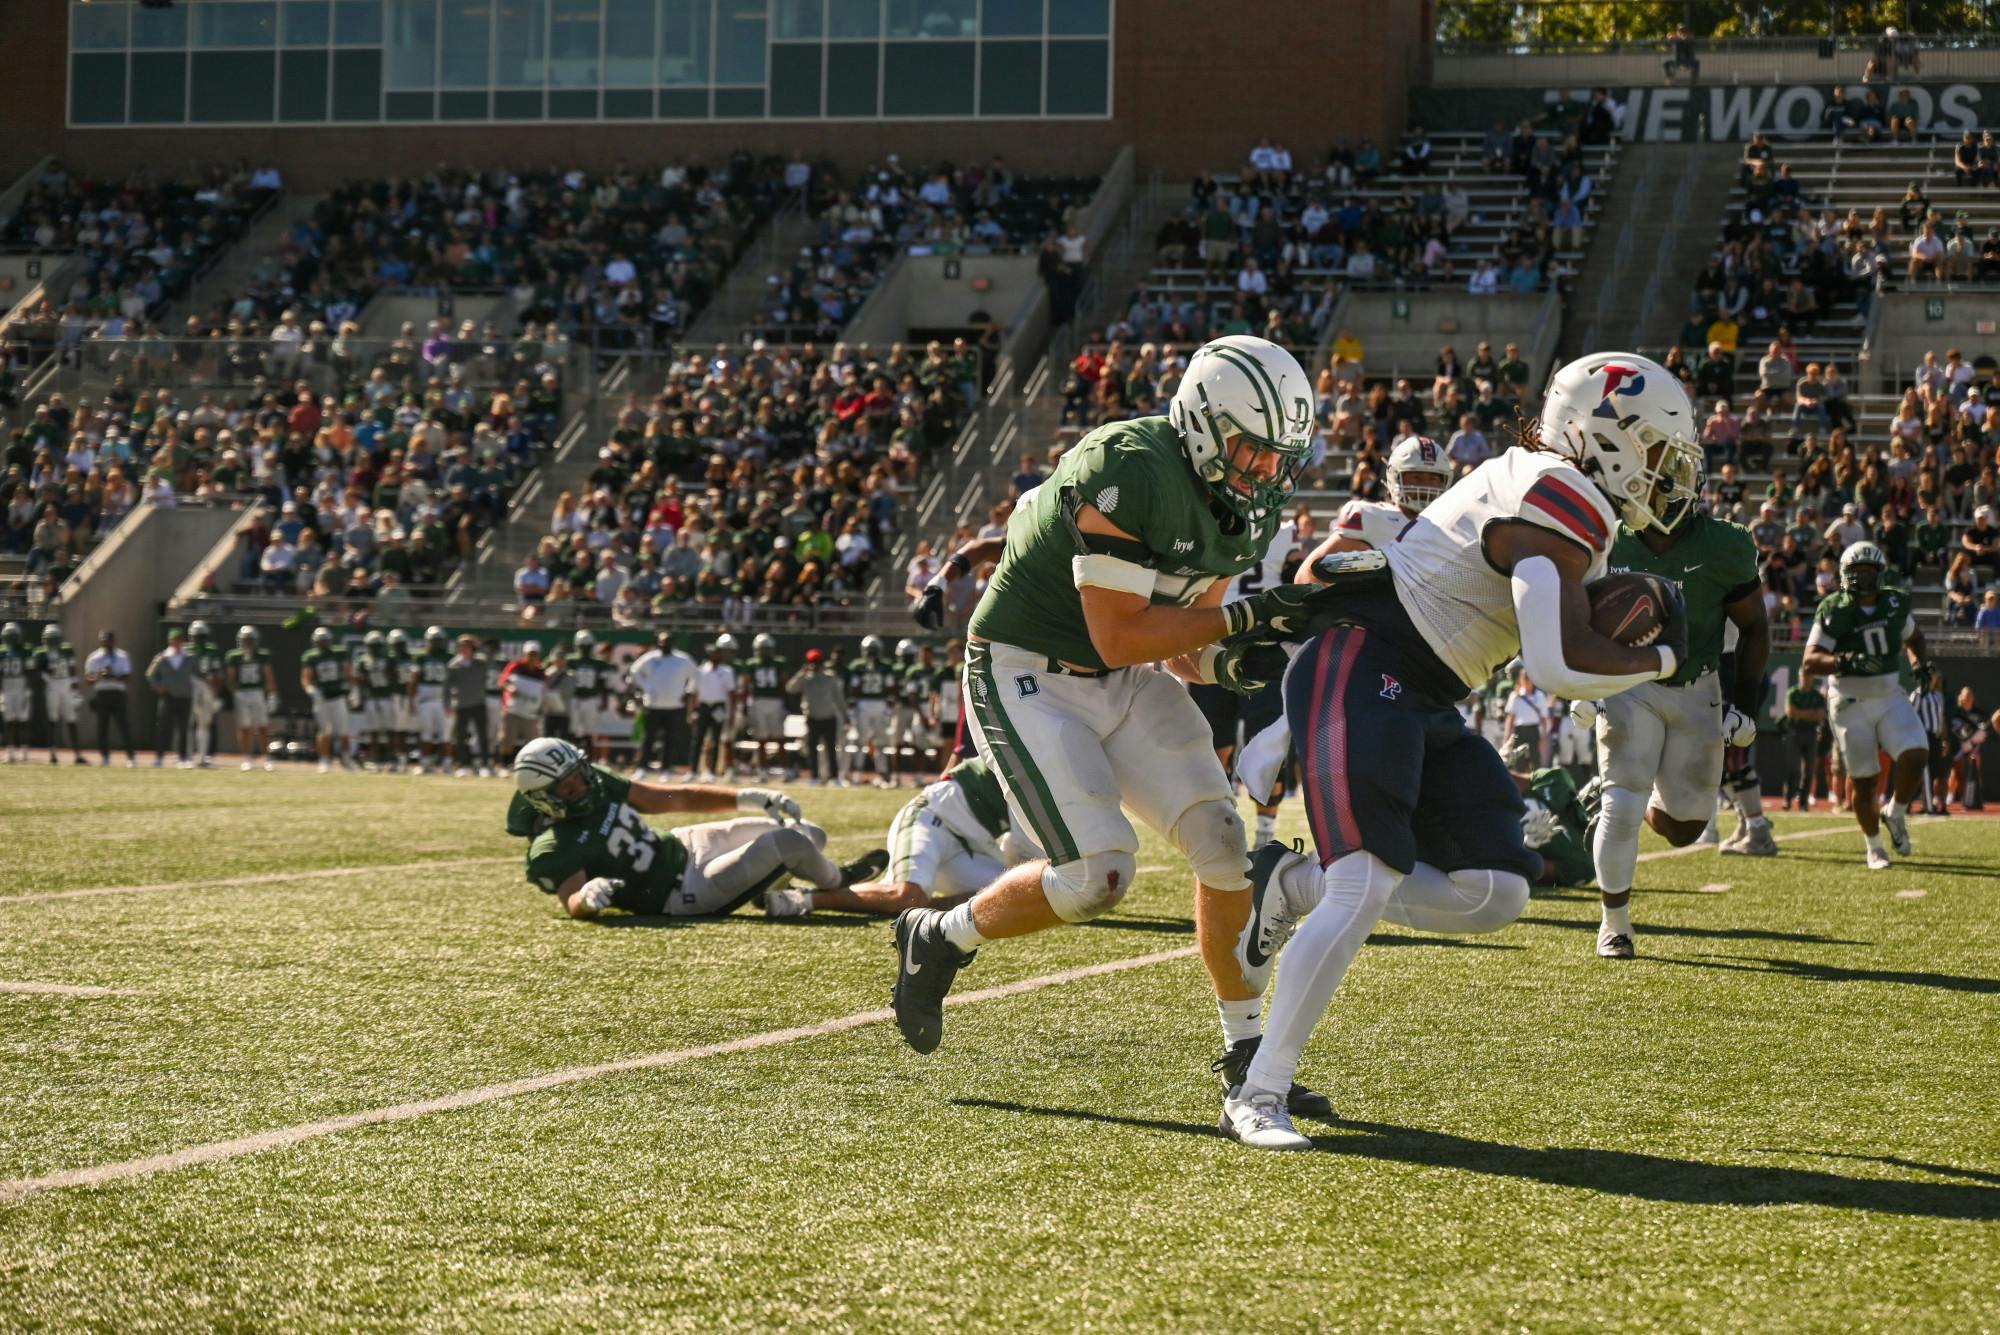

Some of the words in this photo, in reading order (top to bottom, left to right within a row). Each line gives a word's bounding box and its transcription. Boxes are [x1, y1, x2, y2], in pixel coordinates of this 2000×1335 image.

[1591, 365, 1645, 420] P
[1014, 673, 1040, 699] D
[1380, 674, 1401, 700] P
[547, 748, 565, 766] D
